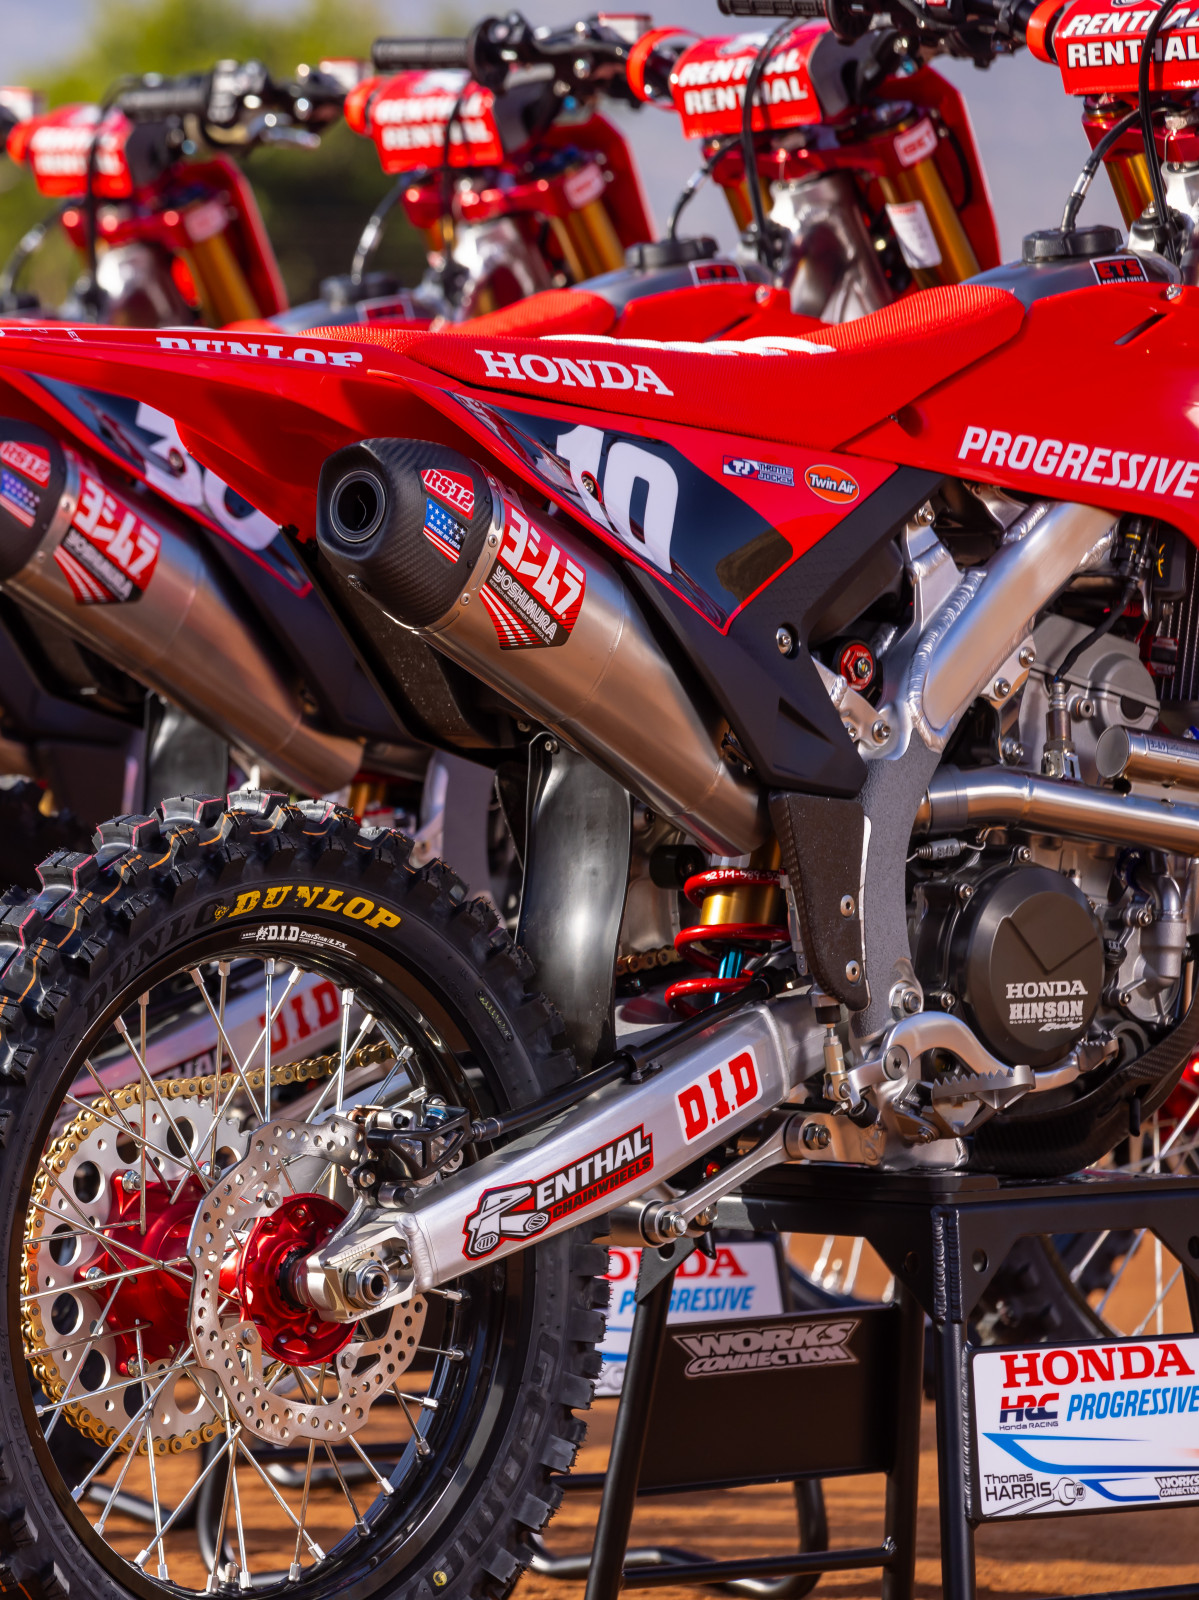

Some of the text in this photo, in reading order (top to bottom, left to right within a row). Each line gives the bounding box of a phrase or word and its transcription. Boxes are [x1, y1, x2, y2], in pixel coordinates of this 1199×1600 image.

[1095, 259, 1141, 279] ETS
[155, 336, 363, 368] DUNLOP
[474, 349, 675, 396] HONDA
[759, 463, 794, 476] THROTTLE
[957, 425, 1199, 499] PROGRESSIVE
[758, 473, 794, 486] JOCKEY
[809, 473, 856, 494] Twin Air
[556, 424, 679, 575] 10
[491, 564, 560, 640] YOSHIMURA
[228, 885, 402, 929] DUNLOP
[1005, 979, 1089, 999] HONDA
[1009, 1000, 1084, 1020] HINSON
[677, 1051, 759, 1141] D.I.D
[552, 1156, 651, 1219] CHAINWHEELS
[618, 1285, 755, 1315] PGRESSIVE
[681, 1322, 853, 1357] WORKS
[687, 1344, 848, 1373] CONNECTION
[1000, 1343, 1195, 1389] HONDA
[999, 1385, 1199, 1423] HRC PROGRESSIVE
[999, 1420, 1059, 1431] Honda RACING
[984, 1472, 1033, 1485] Thomas
[985, 1481, 1051, 1502] HARRIS
[1157, 1475, 1199, 1488] WORKS
